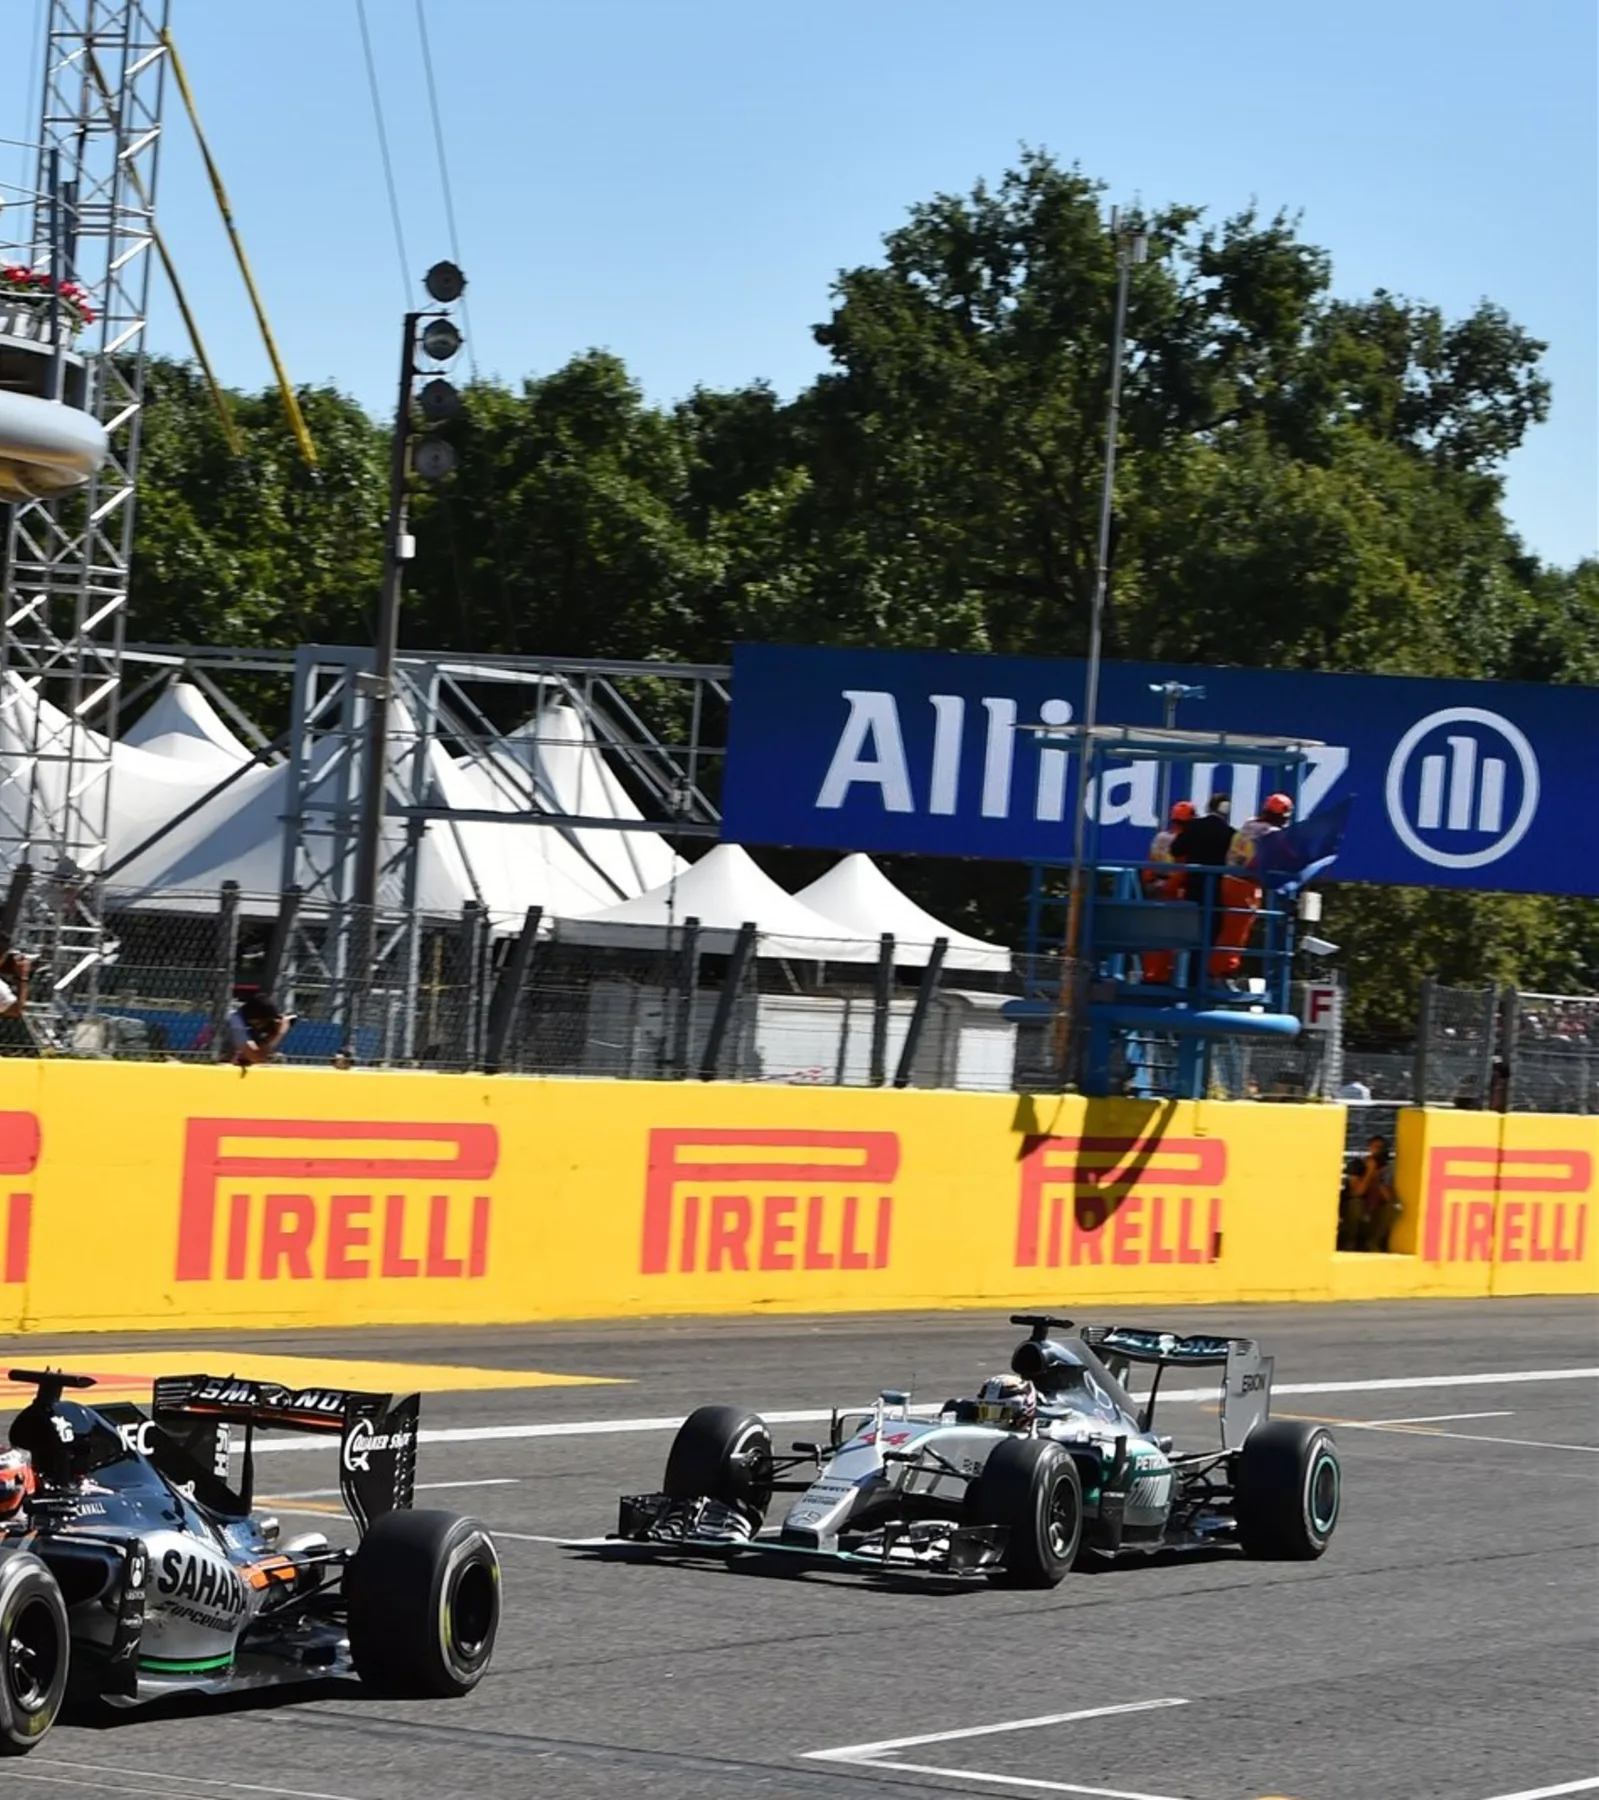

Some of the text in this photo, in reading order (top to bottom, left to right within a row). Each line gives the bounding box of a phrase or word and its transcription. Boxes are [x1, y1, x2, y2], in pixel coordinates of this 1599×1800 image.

[814, 689, 1350, 828] Allianz
[1309, 990, 1333, 1024] F
[174, 1116, 499, 1281] PIRELLI
[640, 1128, 900, 1274] PIRELLI
[1013, 1135, 1227, 1268] PIRELLI
[1423, 1146, 1593, 1263] PIRELLI
[859, 1432, 910, 1446] 44
